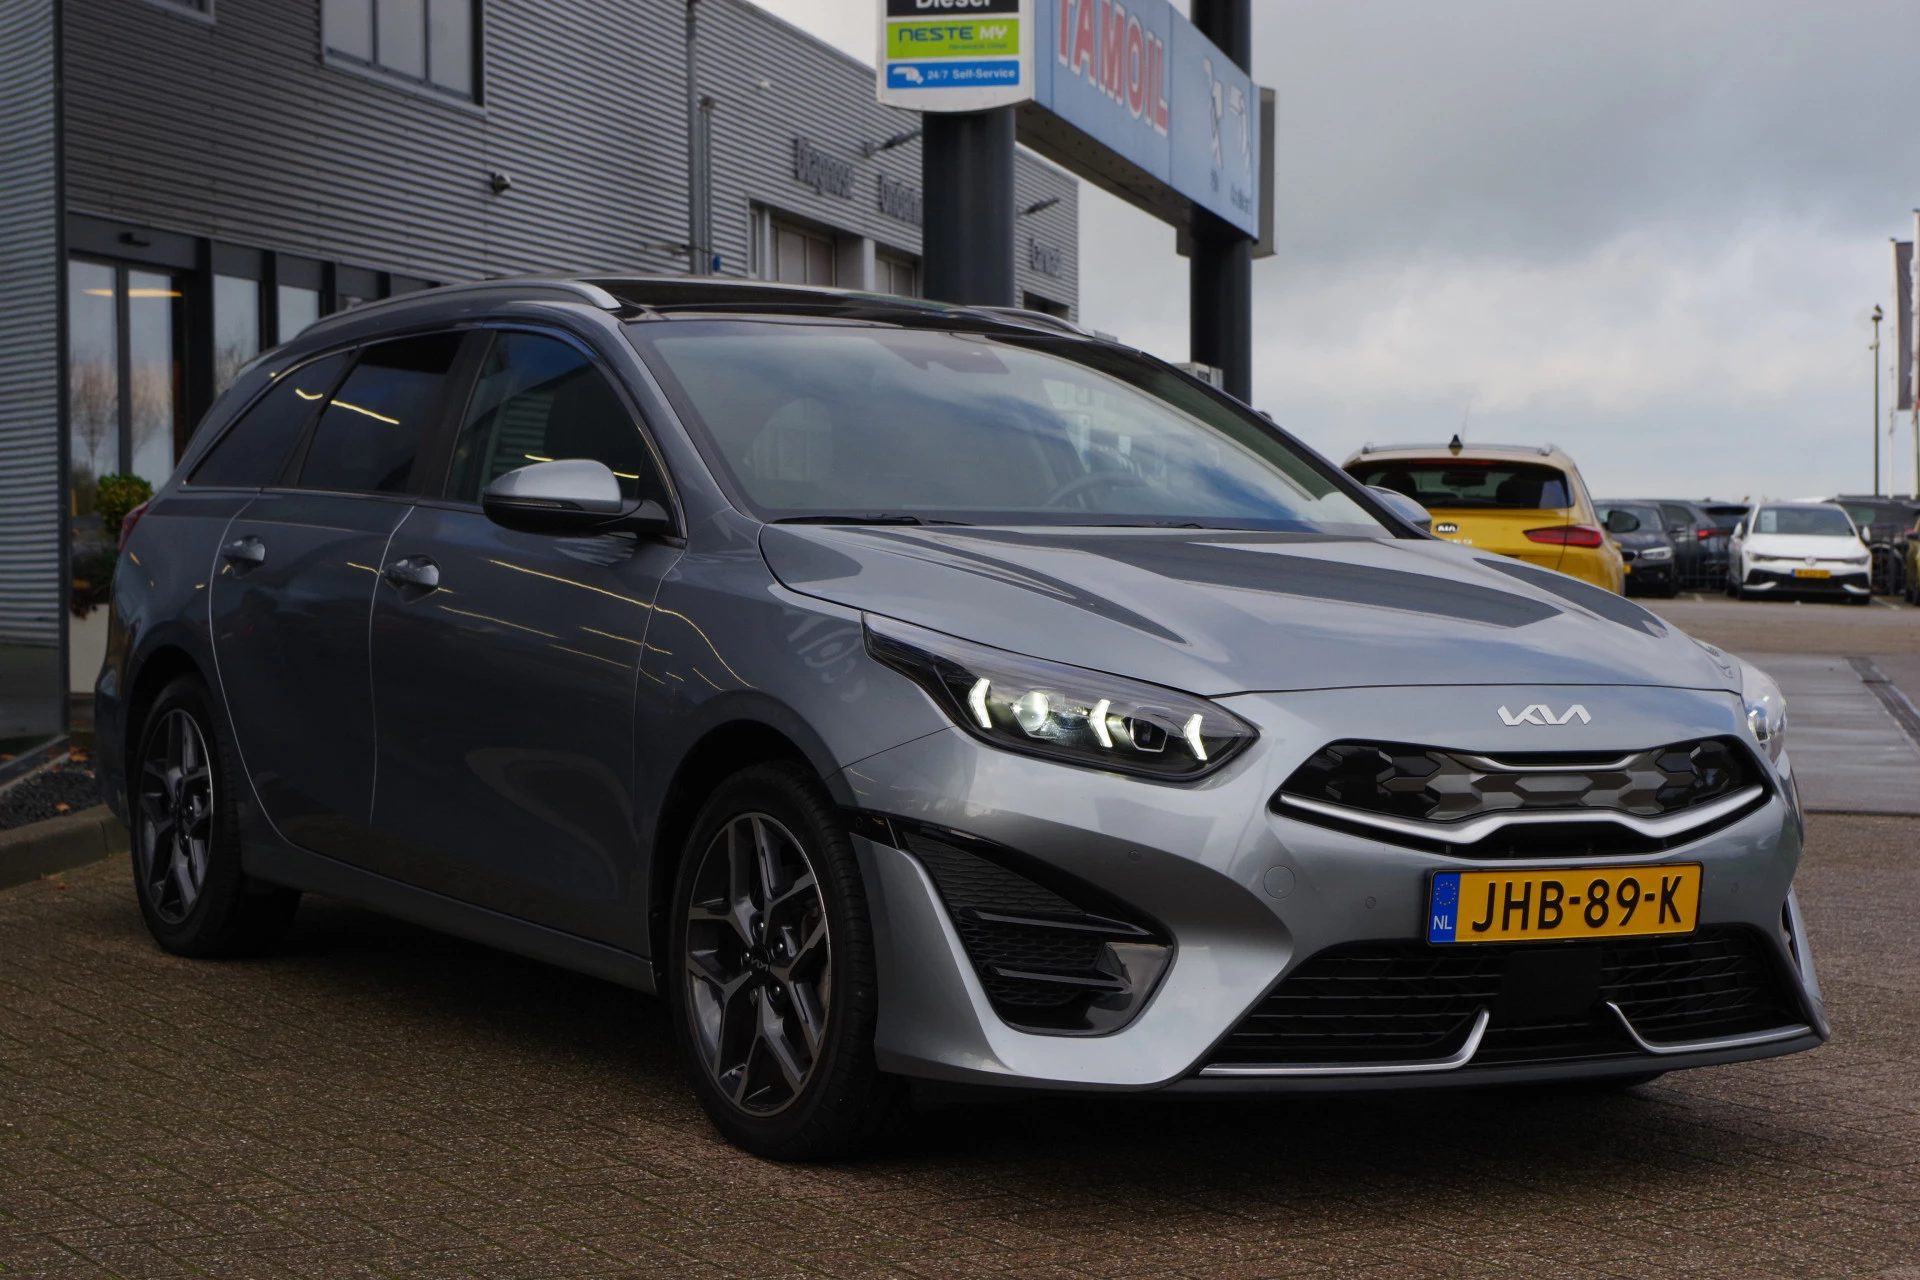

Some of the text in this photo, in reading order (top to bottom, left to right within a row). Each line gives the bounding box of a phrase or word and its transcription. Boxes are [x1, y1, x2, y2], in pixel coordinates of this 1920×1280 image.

[898, 25, 1008, 42] NESTE MY
[927, 68, 1015, 80] 24/7 Self-Service
[1497, 704, 1592, 727] KIA
[1472, 876, 1682, 932] JHB-89-K
[1433, 914, 1452, 930] NL
